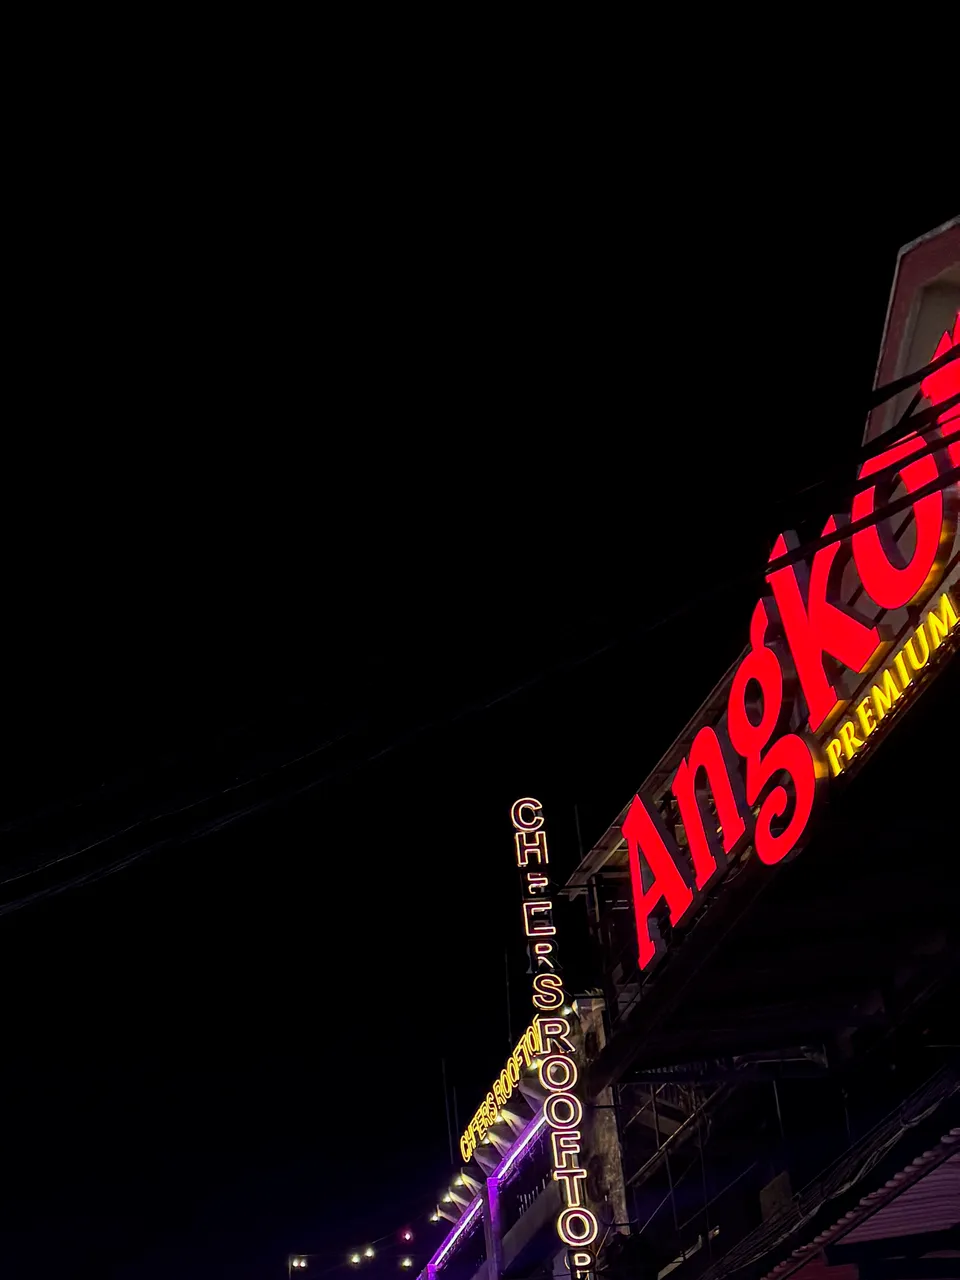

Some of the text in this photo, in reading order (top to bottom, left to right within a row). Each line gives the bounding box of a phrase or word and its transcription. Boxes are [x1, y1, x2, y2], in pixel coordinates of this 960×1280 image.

[825, 592, 960, 778] PREMIUM
[511, 797, 565, 1012] CHEERS
[460, 1091, 498, 1163] CHEERS
